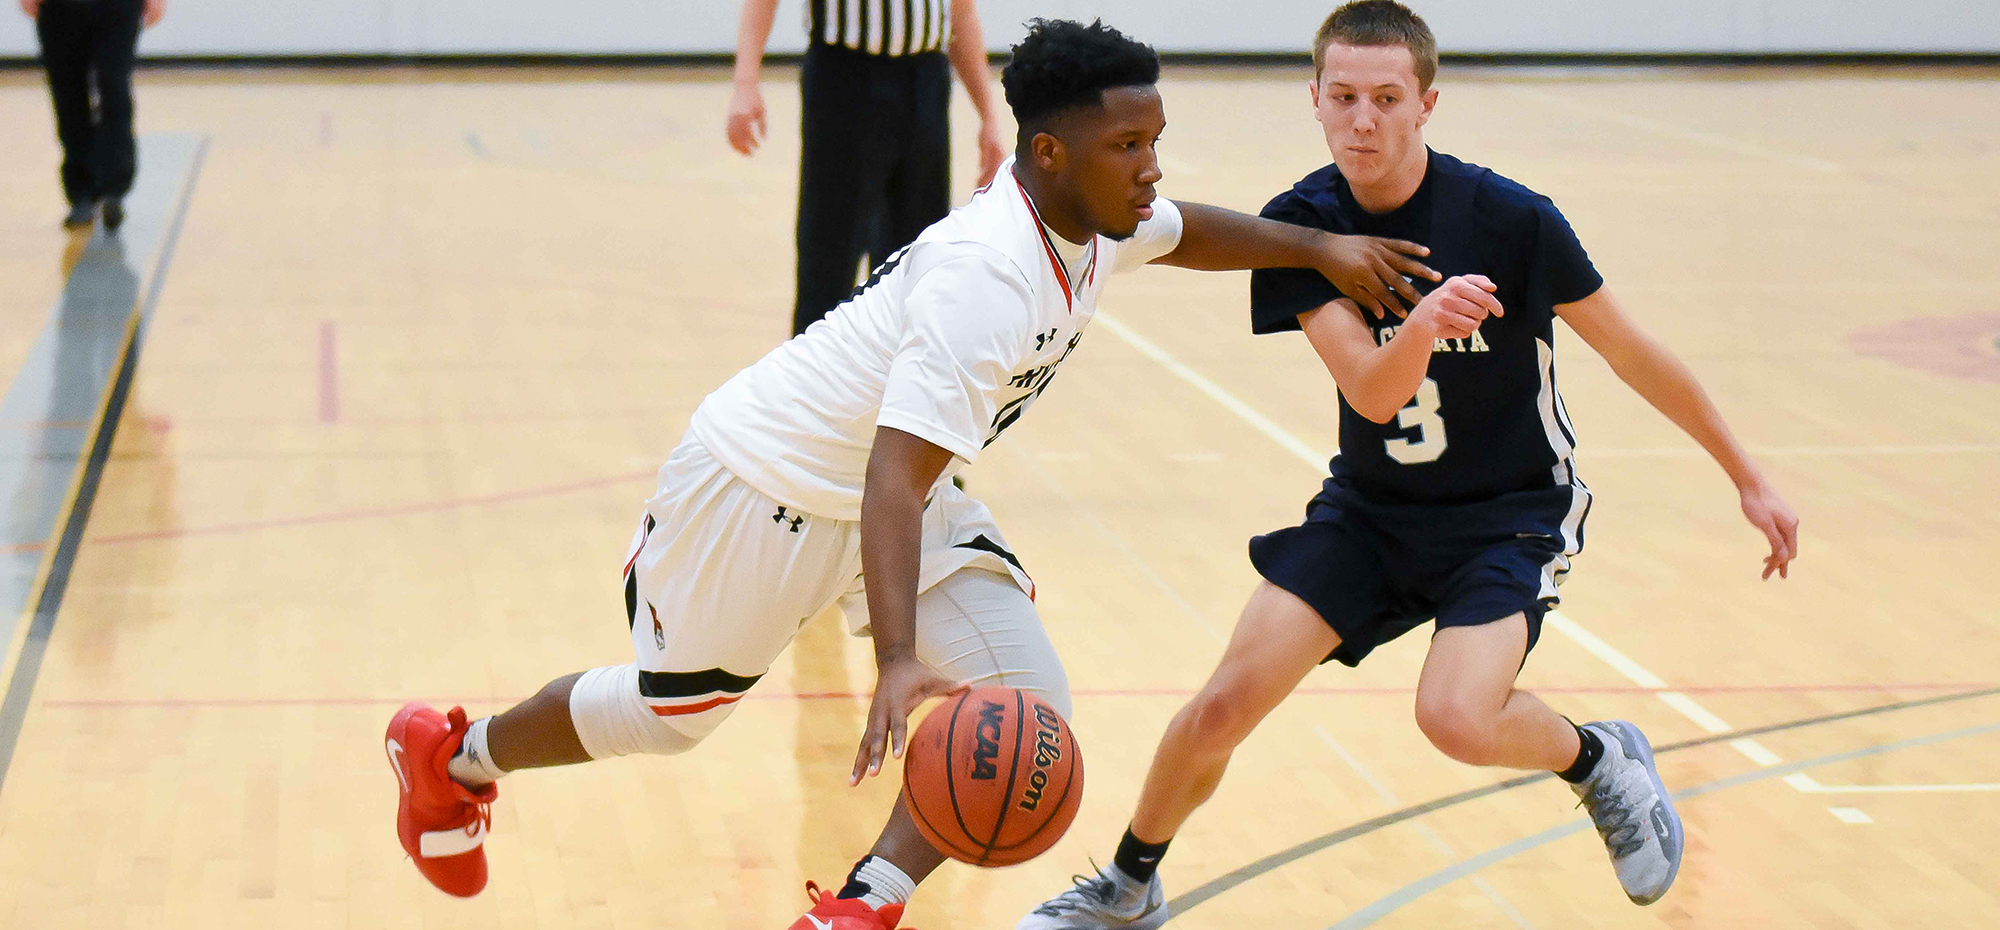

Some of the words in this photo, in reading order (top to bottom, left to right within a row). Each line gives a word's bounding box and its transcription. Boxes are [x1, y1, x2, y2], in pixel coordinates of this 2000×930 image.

[1384, 376, 1448, 465] 3
[971, 700, 1006, 780] NCAA
[1017, 703, 1062, 812] Wilson
